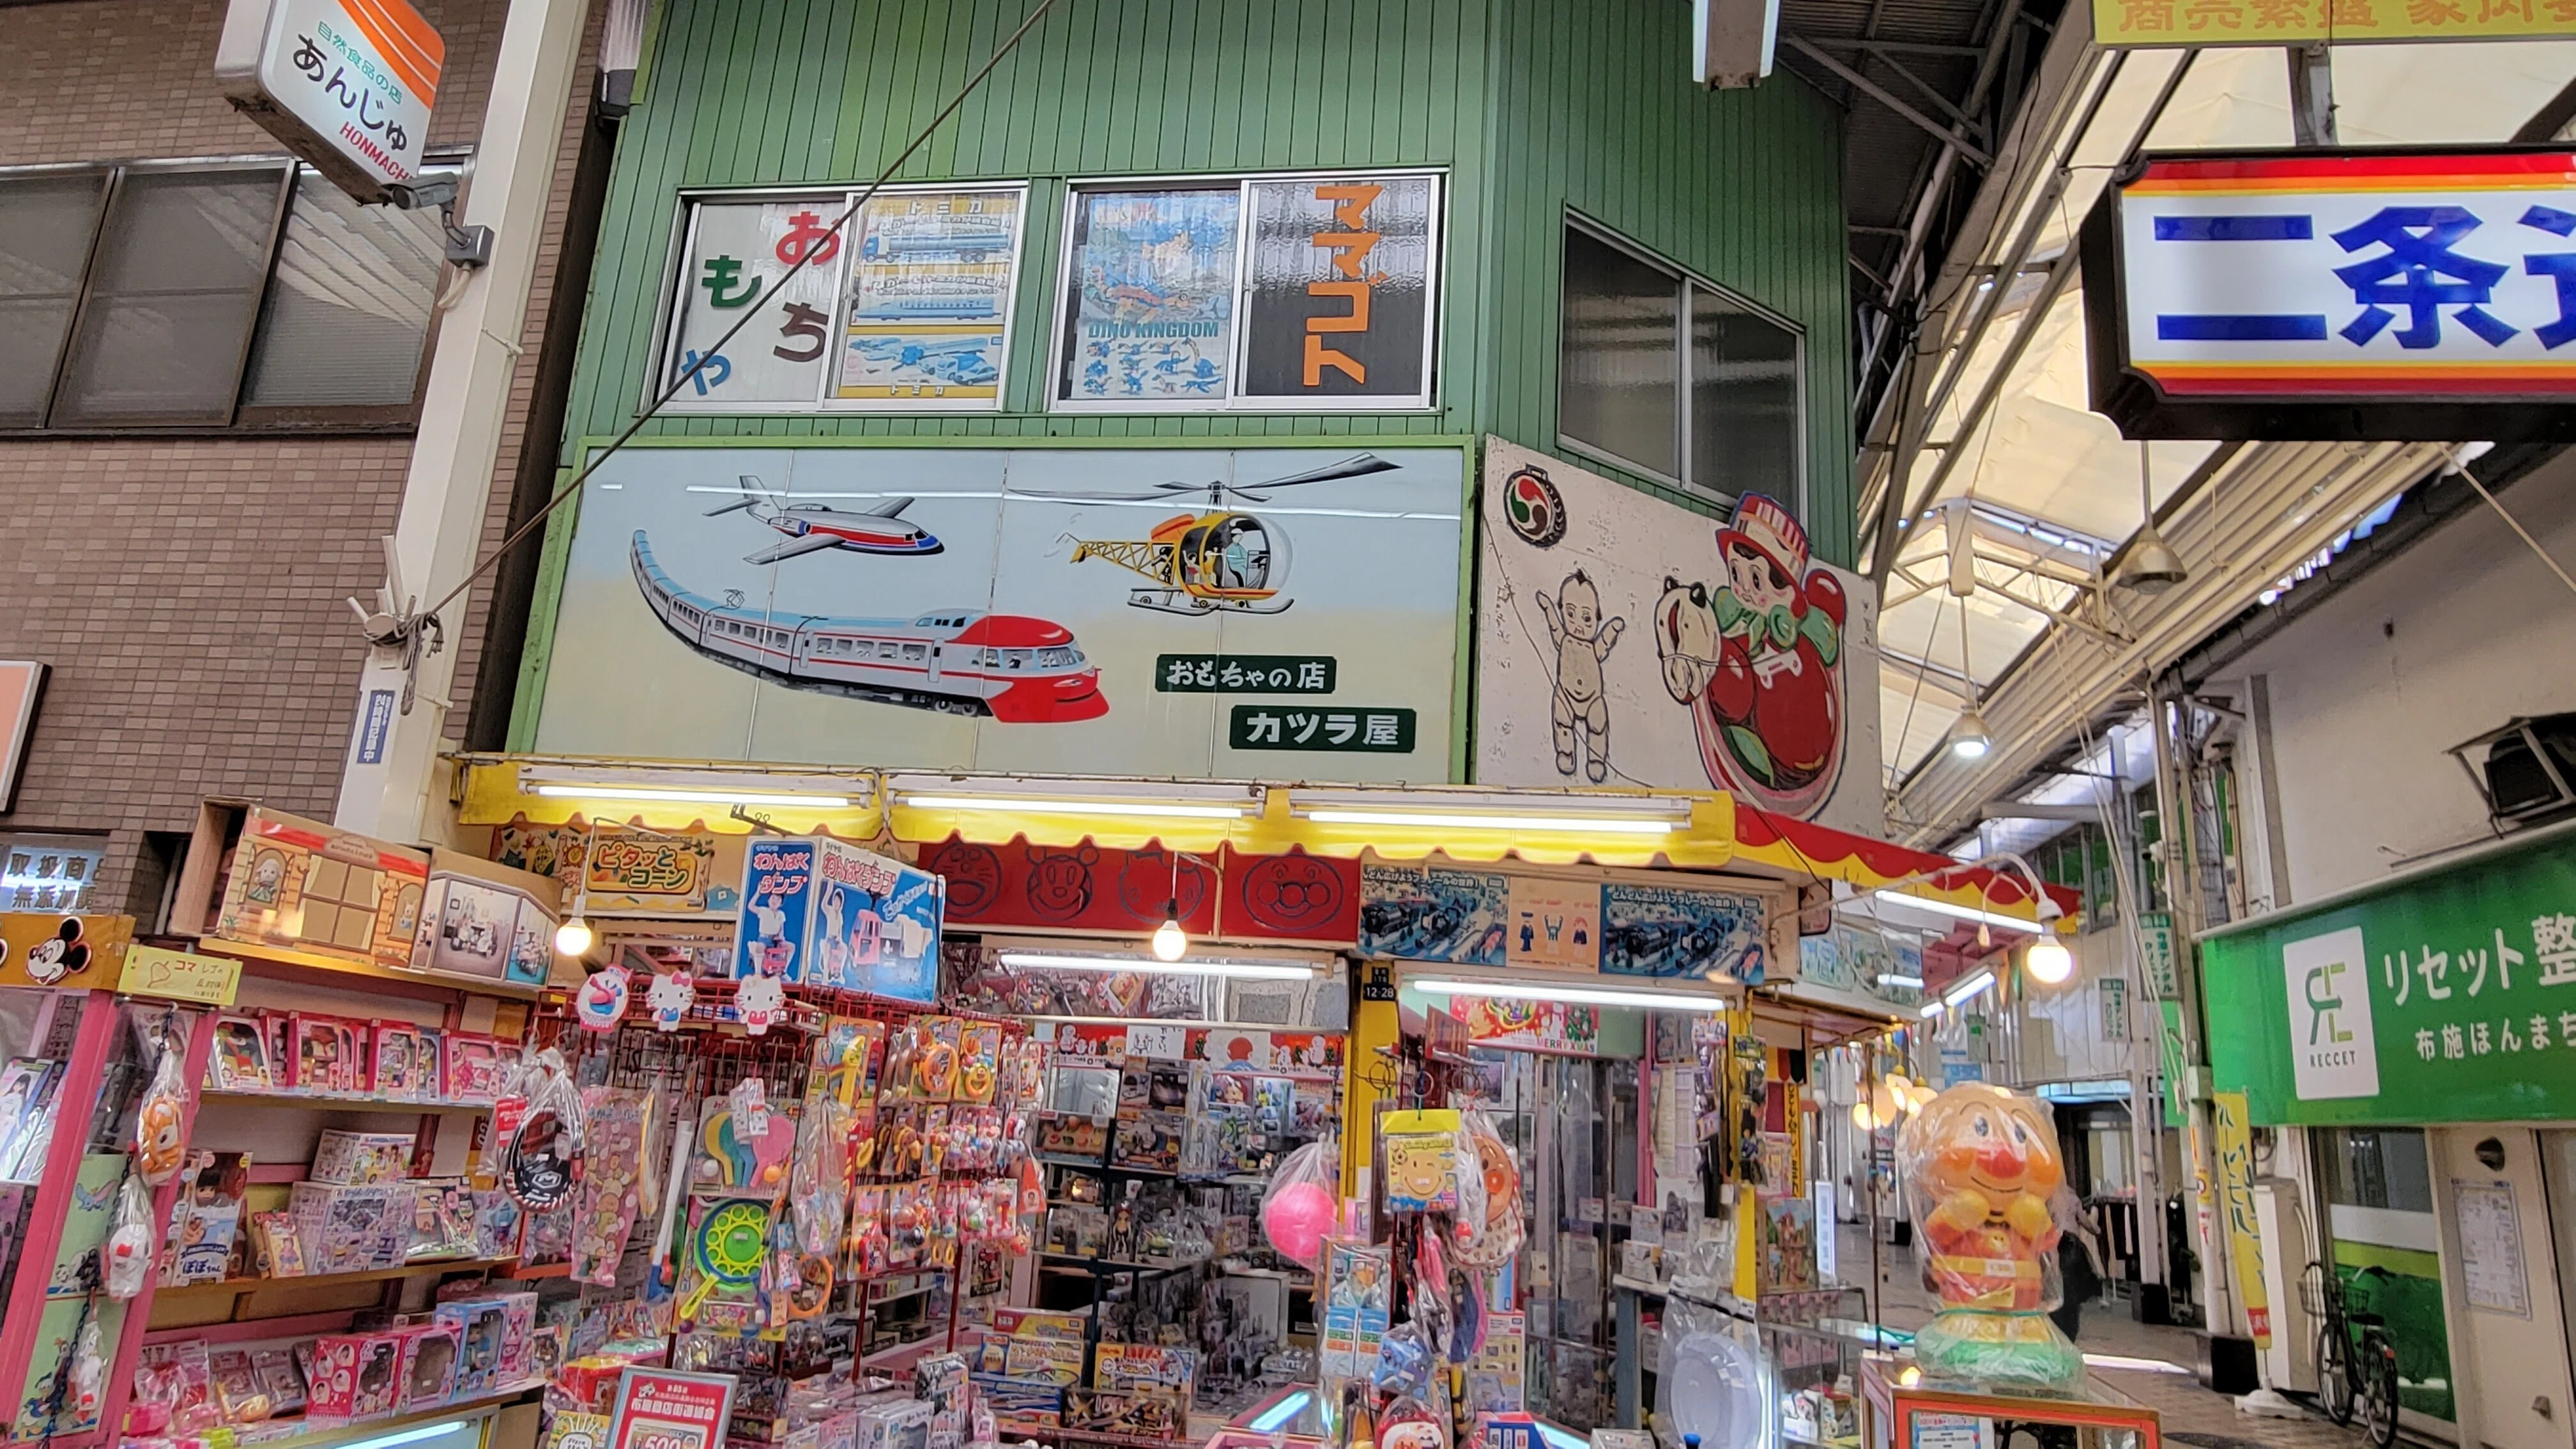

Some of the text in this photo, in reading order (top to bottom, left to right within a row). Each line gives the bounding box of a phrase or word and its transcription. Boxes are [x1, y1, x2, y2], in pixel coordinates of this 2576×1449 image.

[317, 20, 402, 105] 自然食品の店
[293, 34, 407, 151] あんじゅ
[339, 121, 414, 181] HONMACH
[1088, 321, 1220, 339] DINO KINGDOM
[1166, 660, 1326, 689] おもちゃの店
[1246, 712, 1399, 746] カツラ屋
[753, 852, 811, 871] わんぱく
[173, 959, 197, 973] コマ
